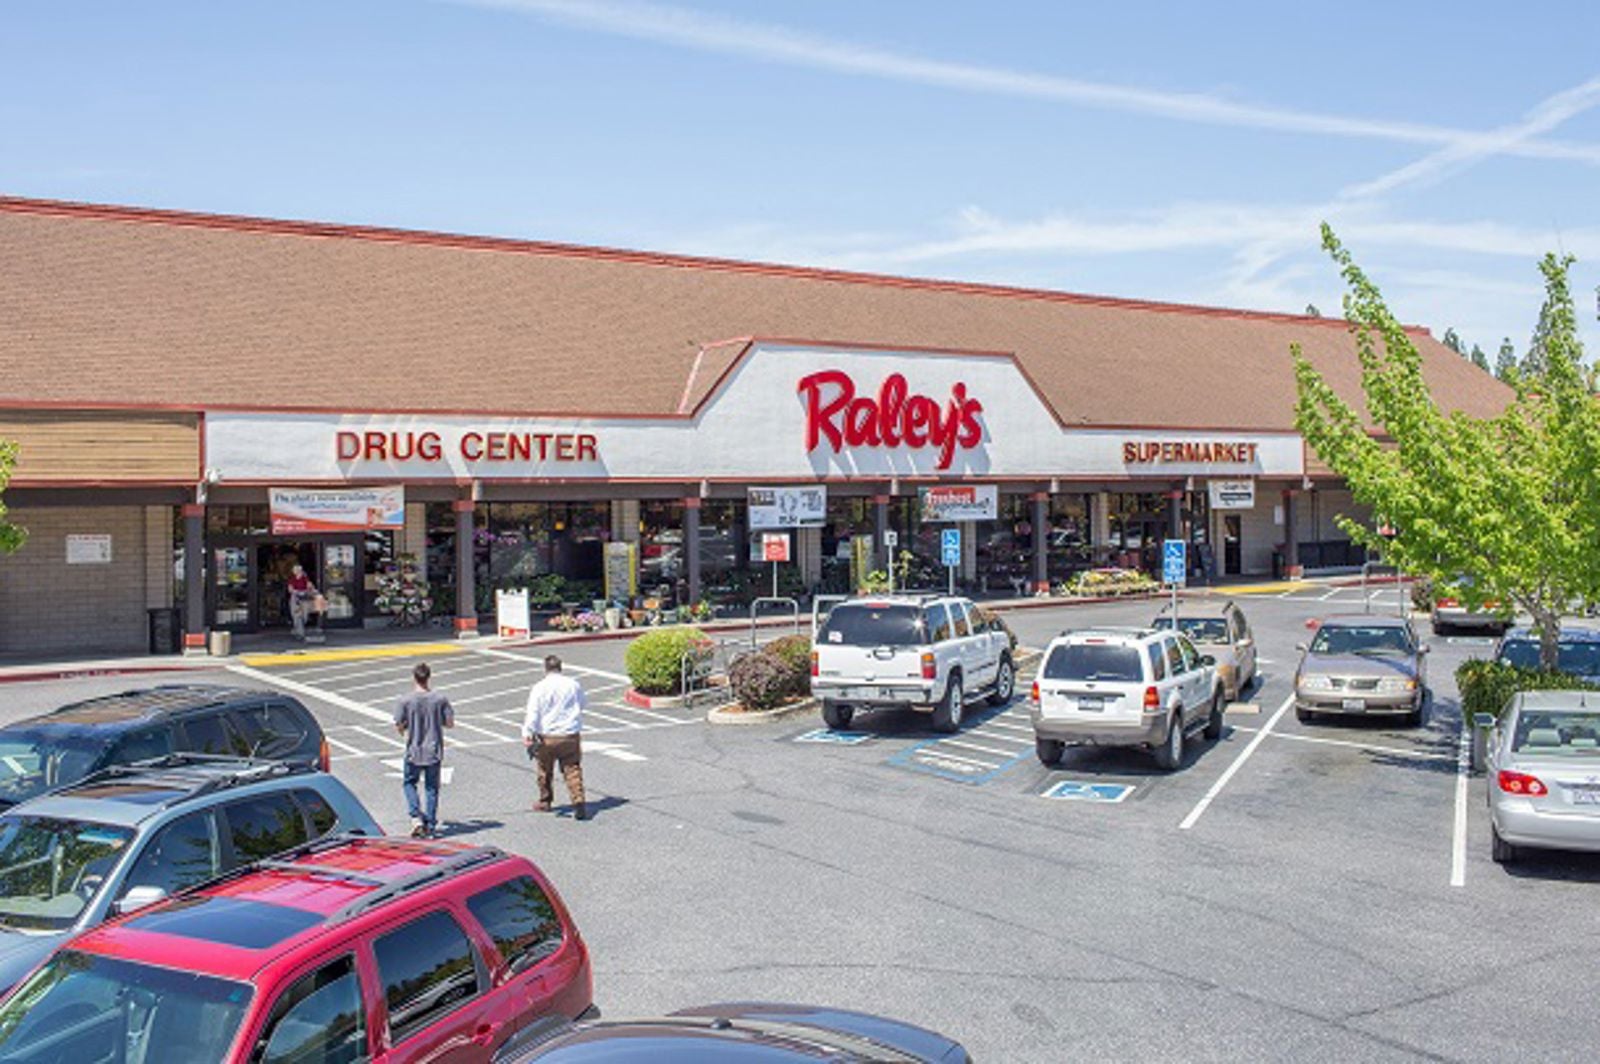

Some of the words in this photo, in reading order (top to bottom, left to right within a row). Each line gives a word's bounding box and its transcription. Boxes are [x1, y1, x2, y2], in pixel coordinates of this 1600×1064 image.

[797, 368, 984, 470] Raley's
[335, 431, 443, 461] DRUG
[460, 431, 600, 462] CENTER
[1122, 442, 1259, 464] SUPERMARKET
